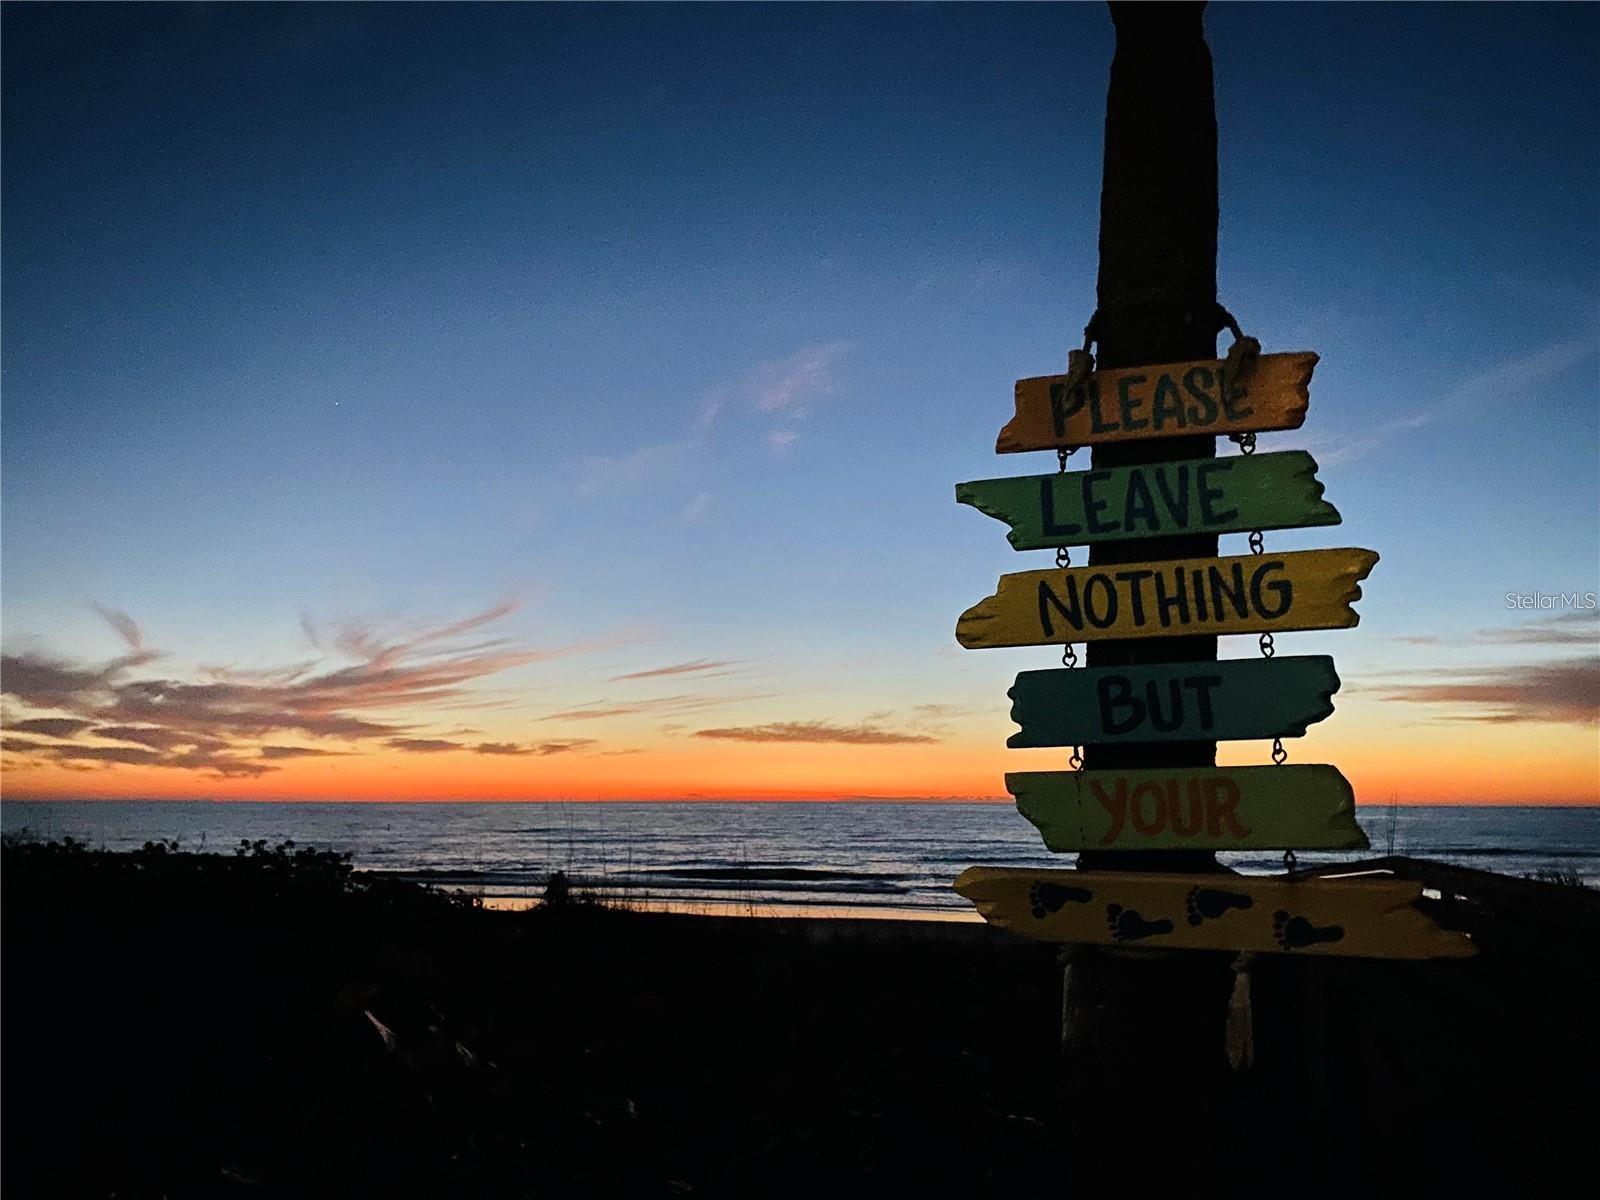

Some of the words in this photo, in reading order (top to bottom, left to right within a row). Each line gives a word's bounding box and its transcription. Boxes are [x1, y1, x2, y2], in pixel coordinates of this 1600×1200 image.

[1050, 367, 1254, 437] PLEASE
[1040, 462, 1238, 536] LEAVE
[1038, 562, 1293, 637] NOTHING
[1096, 675, 1222, 734] BUT
[1090, 776, 1251, 844] YOUR
